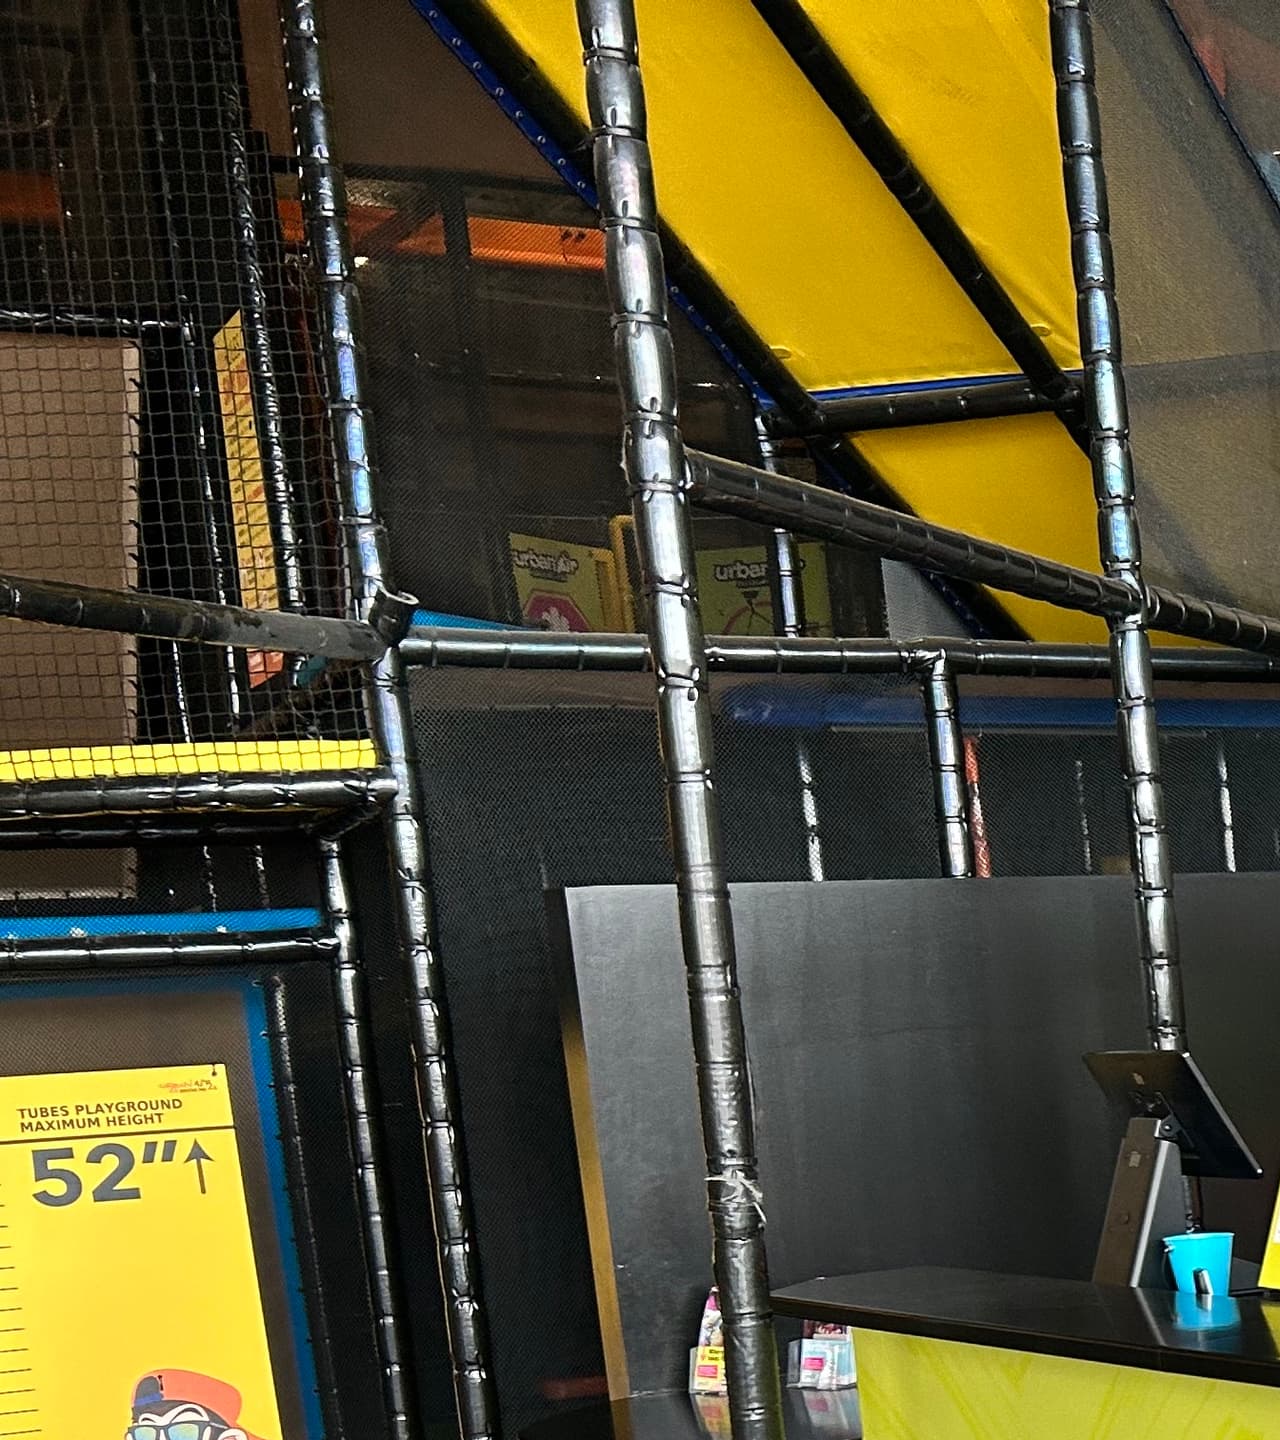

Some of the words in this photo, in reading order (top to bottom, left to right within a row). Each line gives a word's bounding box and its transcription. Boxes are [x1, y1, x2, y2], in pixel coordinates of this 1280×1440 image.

[17, 1106, 69, 1119] TUBES
[75, 1099, 183, 1115] PLAYGROUND
[20, 1118, 101, 1133] MAXIMUM
[107, 1113, 164, 1127] HEIGHT
